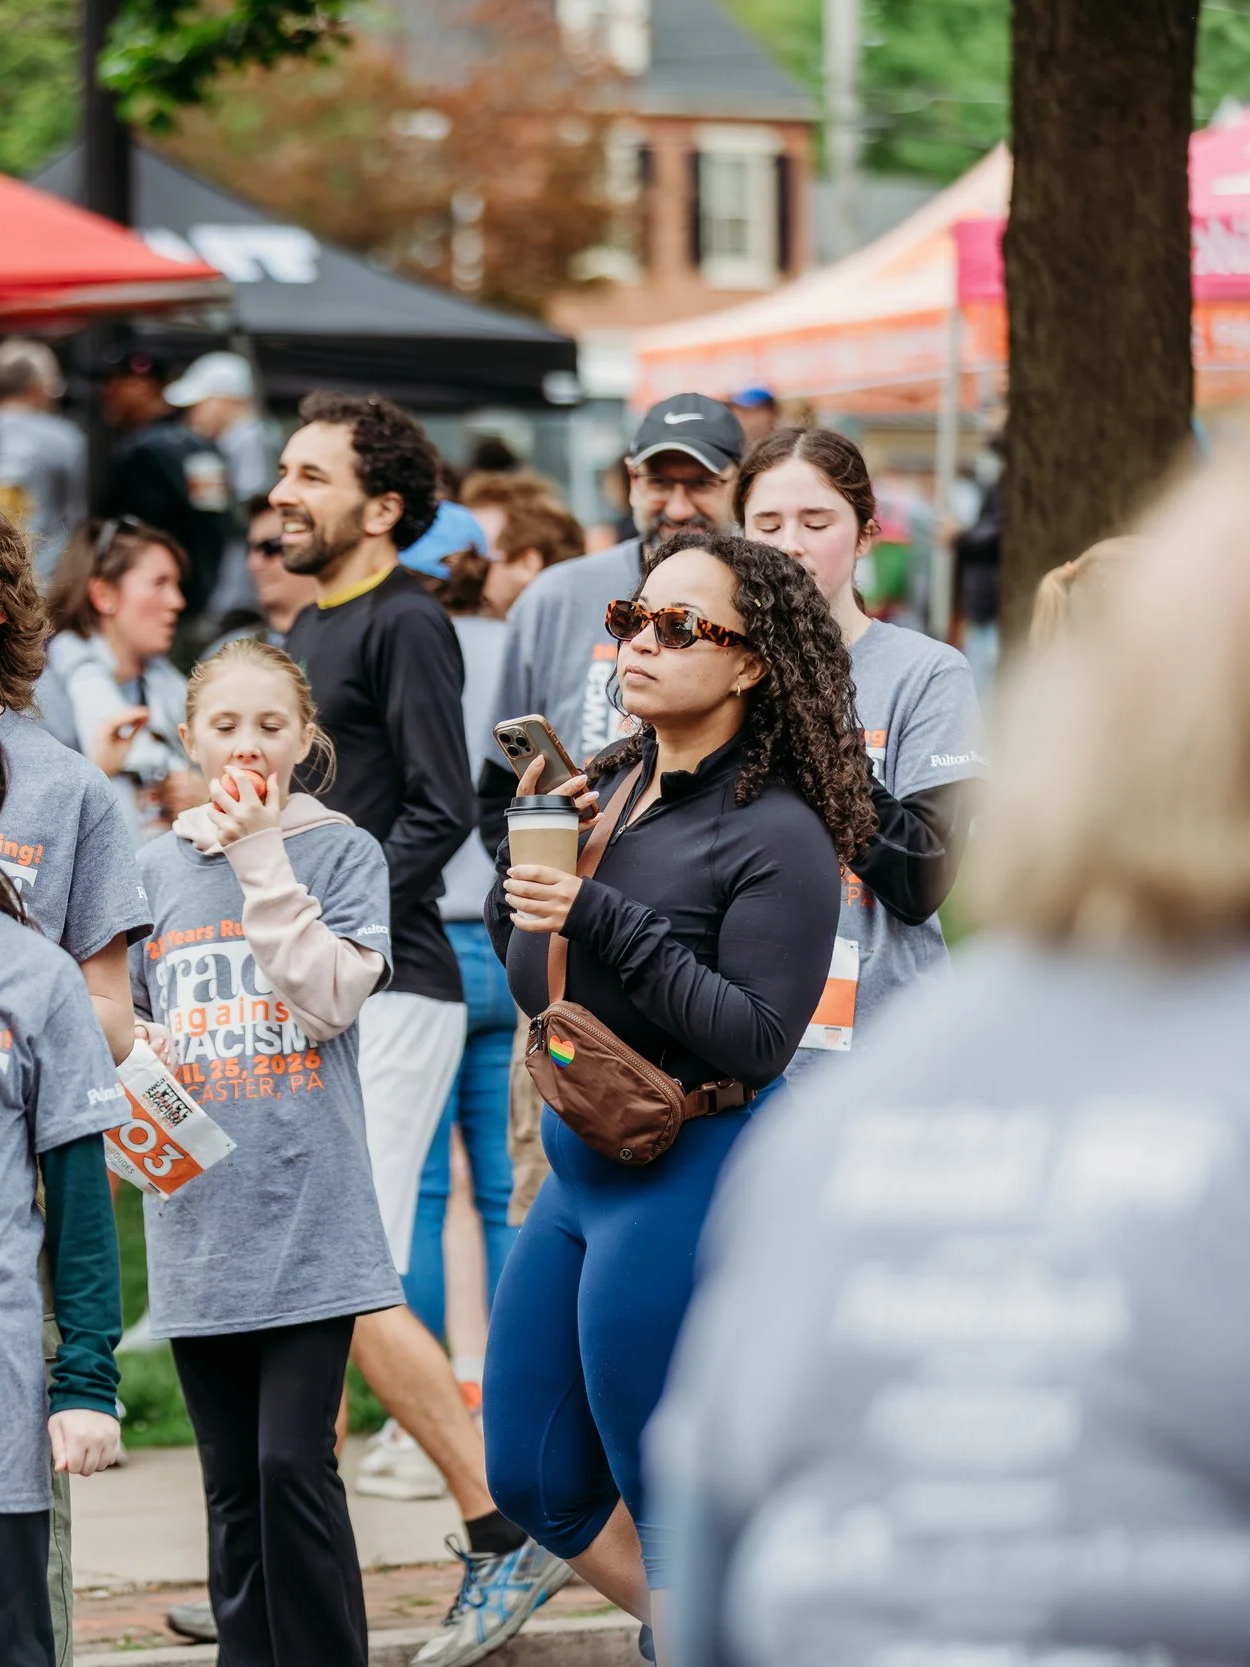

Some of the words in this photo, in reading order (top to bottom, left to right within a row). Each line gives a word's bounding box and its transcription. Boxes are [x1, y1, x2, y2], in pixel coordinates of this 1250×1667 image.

[929, 754, 970, 768] Fulton
[167, 924, 215, 949] Years
[174, 996, 291, 1037] agains
[252, 1049, 322, 1077] 2026
[290, 1071, 325, 1096] PA
